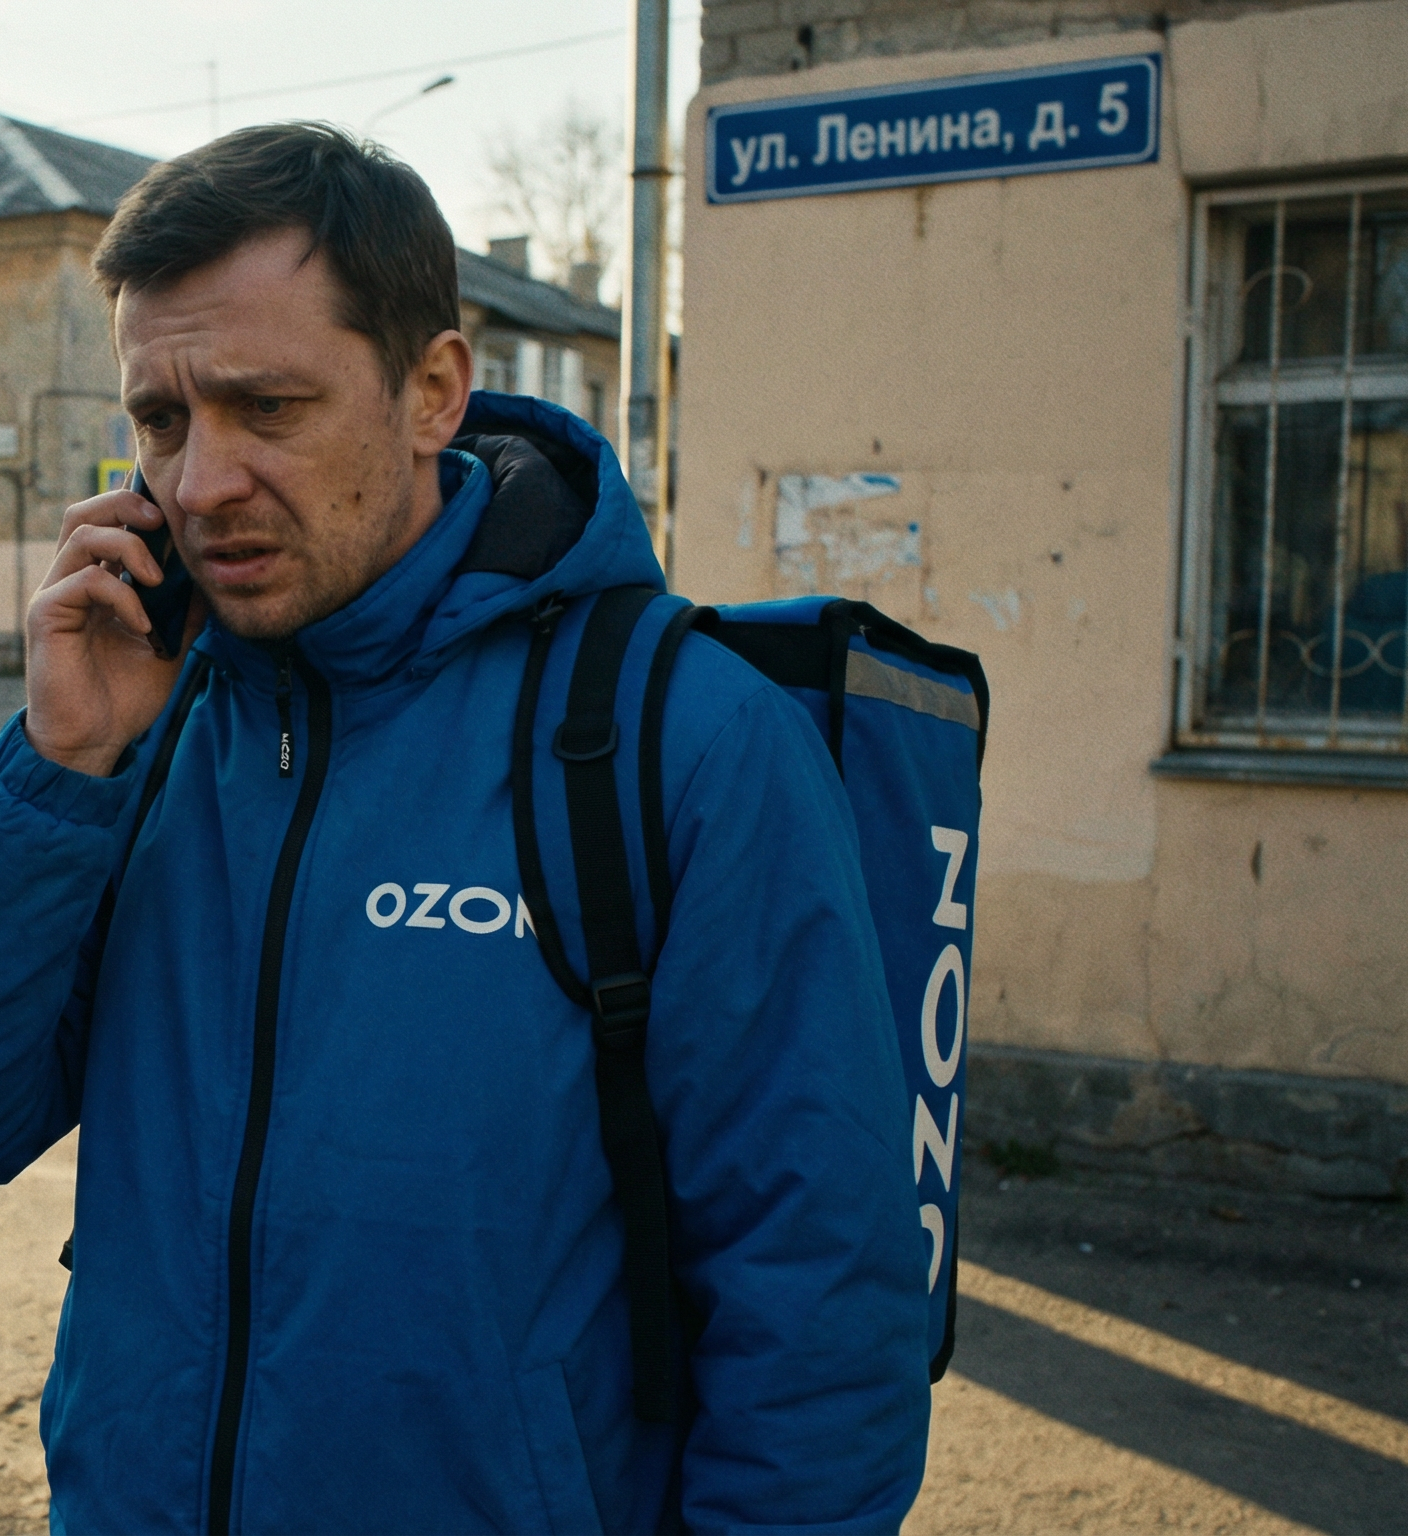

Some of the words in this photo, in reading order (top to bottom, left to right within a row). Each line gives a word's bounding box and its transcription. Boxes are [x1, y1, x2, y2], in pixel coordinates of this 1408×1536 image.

[730, 133, 799, 186] ул.
[813, 107, 1014, 164] Ленина,
[1029, 101, 1080, 150] д.
[1098, 82, 1130, 136] 5
